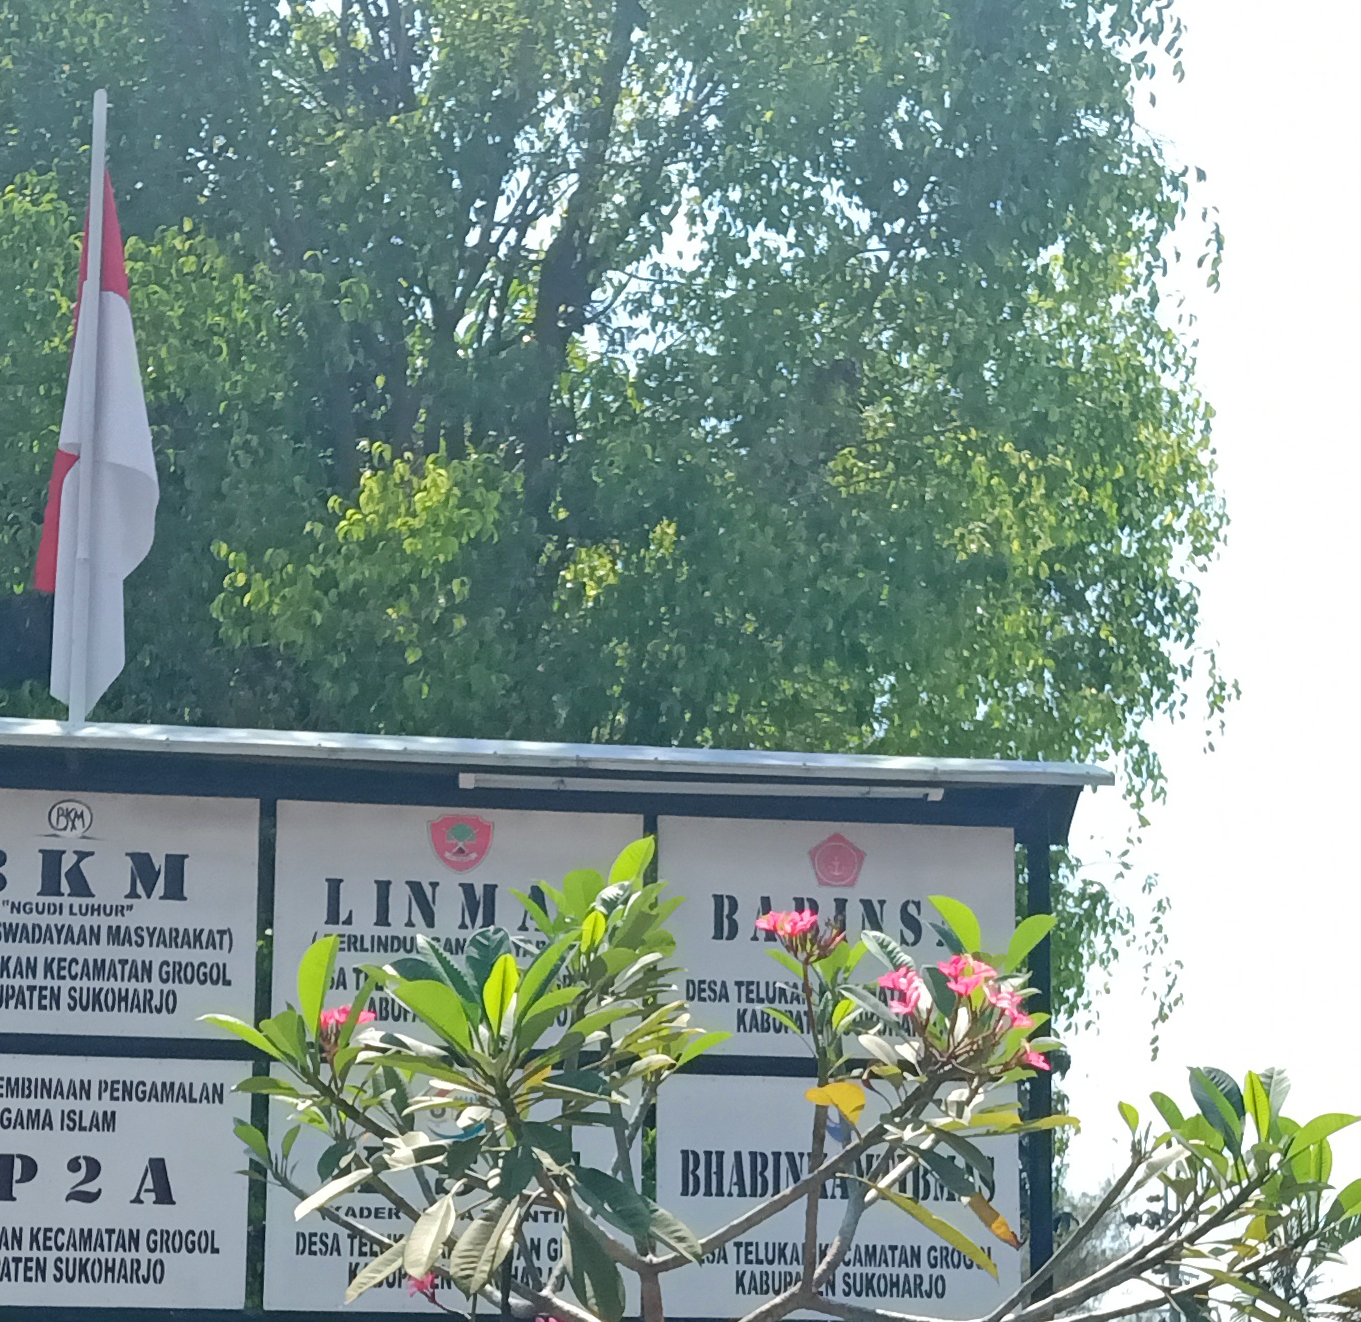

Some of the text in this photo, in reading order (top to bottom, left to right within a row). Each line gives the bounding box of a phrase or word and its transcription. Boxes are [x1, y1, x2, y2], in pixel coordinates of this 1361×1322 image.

[325, 878, 549, 932] LINMA
[44, 957, 152, 983] KECAMATAN
[159, 960, 231, 986] GROGOL
[68, 987, 177, 1014] SUKOHARJO
[685, 978, 730, 1004] DESA
[98, 1080, 223, 1104] PENGAMALAN
[61, 1110, 116, 1132] ISLAM
[30, 1227, 140, 1252] KECAMATAN
[146, 1229, 219, 1254] GROGOL
[295, 1231, 342, 1257] DESA
[53, 1257, 164, 1284] SUKOHARJO
[842, 1271, 947, 1300] SUKOHARJO
